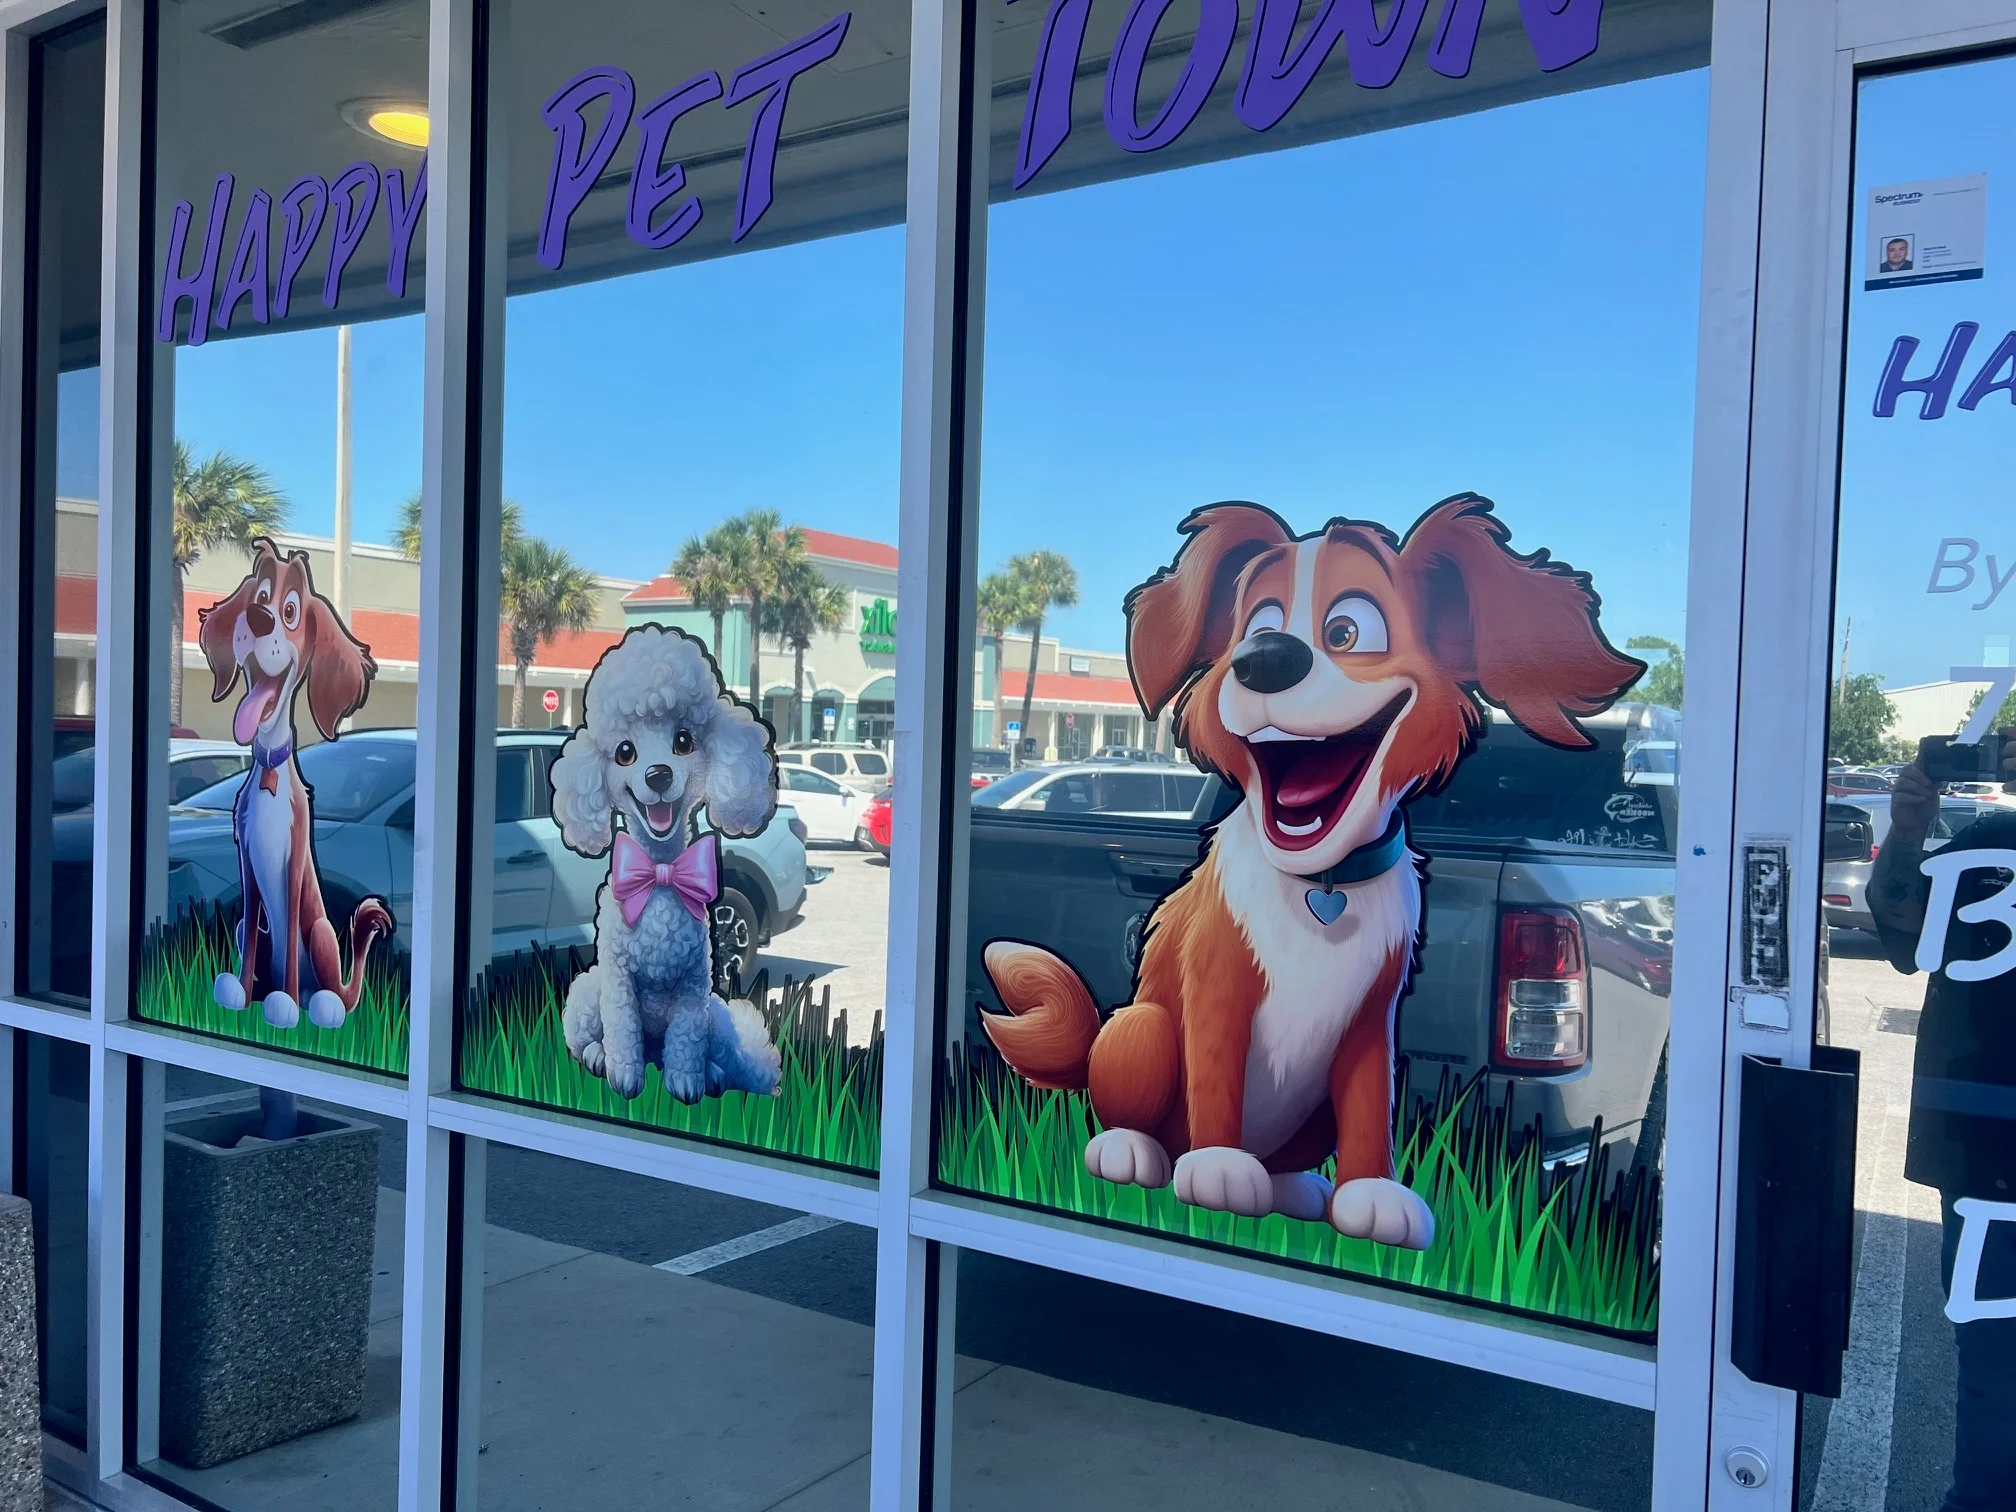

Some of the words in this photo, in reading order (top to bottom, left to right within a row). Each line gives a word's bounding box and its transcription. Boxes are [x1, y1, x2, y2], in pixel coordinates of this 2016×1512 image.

[157, 147, 427, 347] HAPPY
[536, 11, 852, 271] PET
[1875, 192, 1921, 205] Spectrum
[1926, 537, 2016, 611] By
